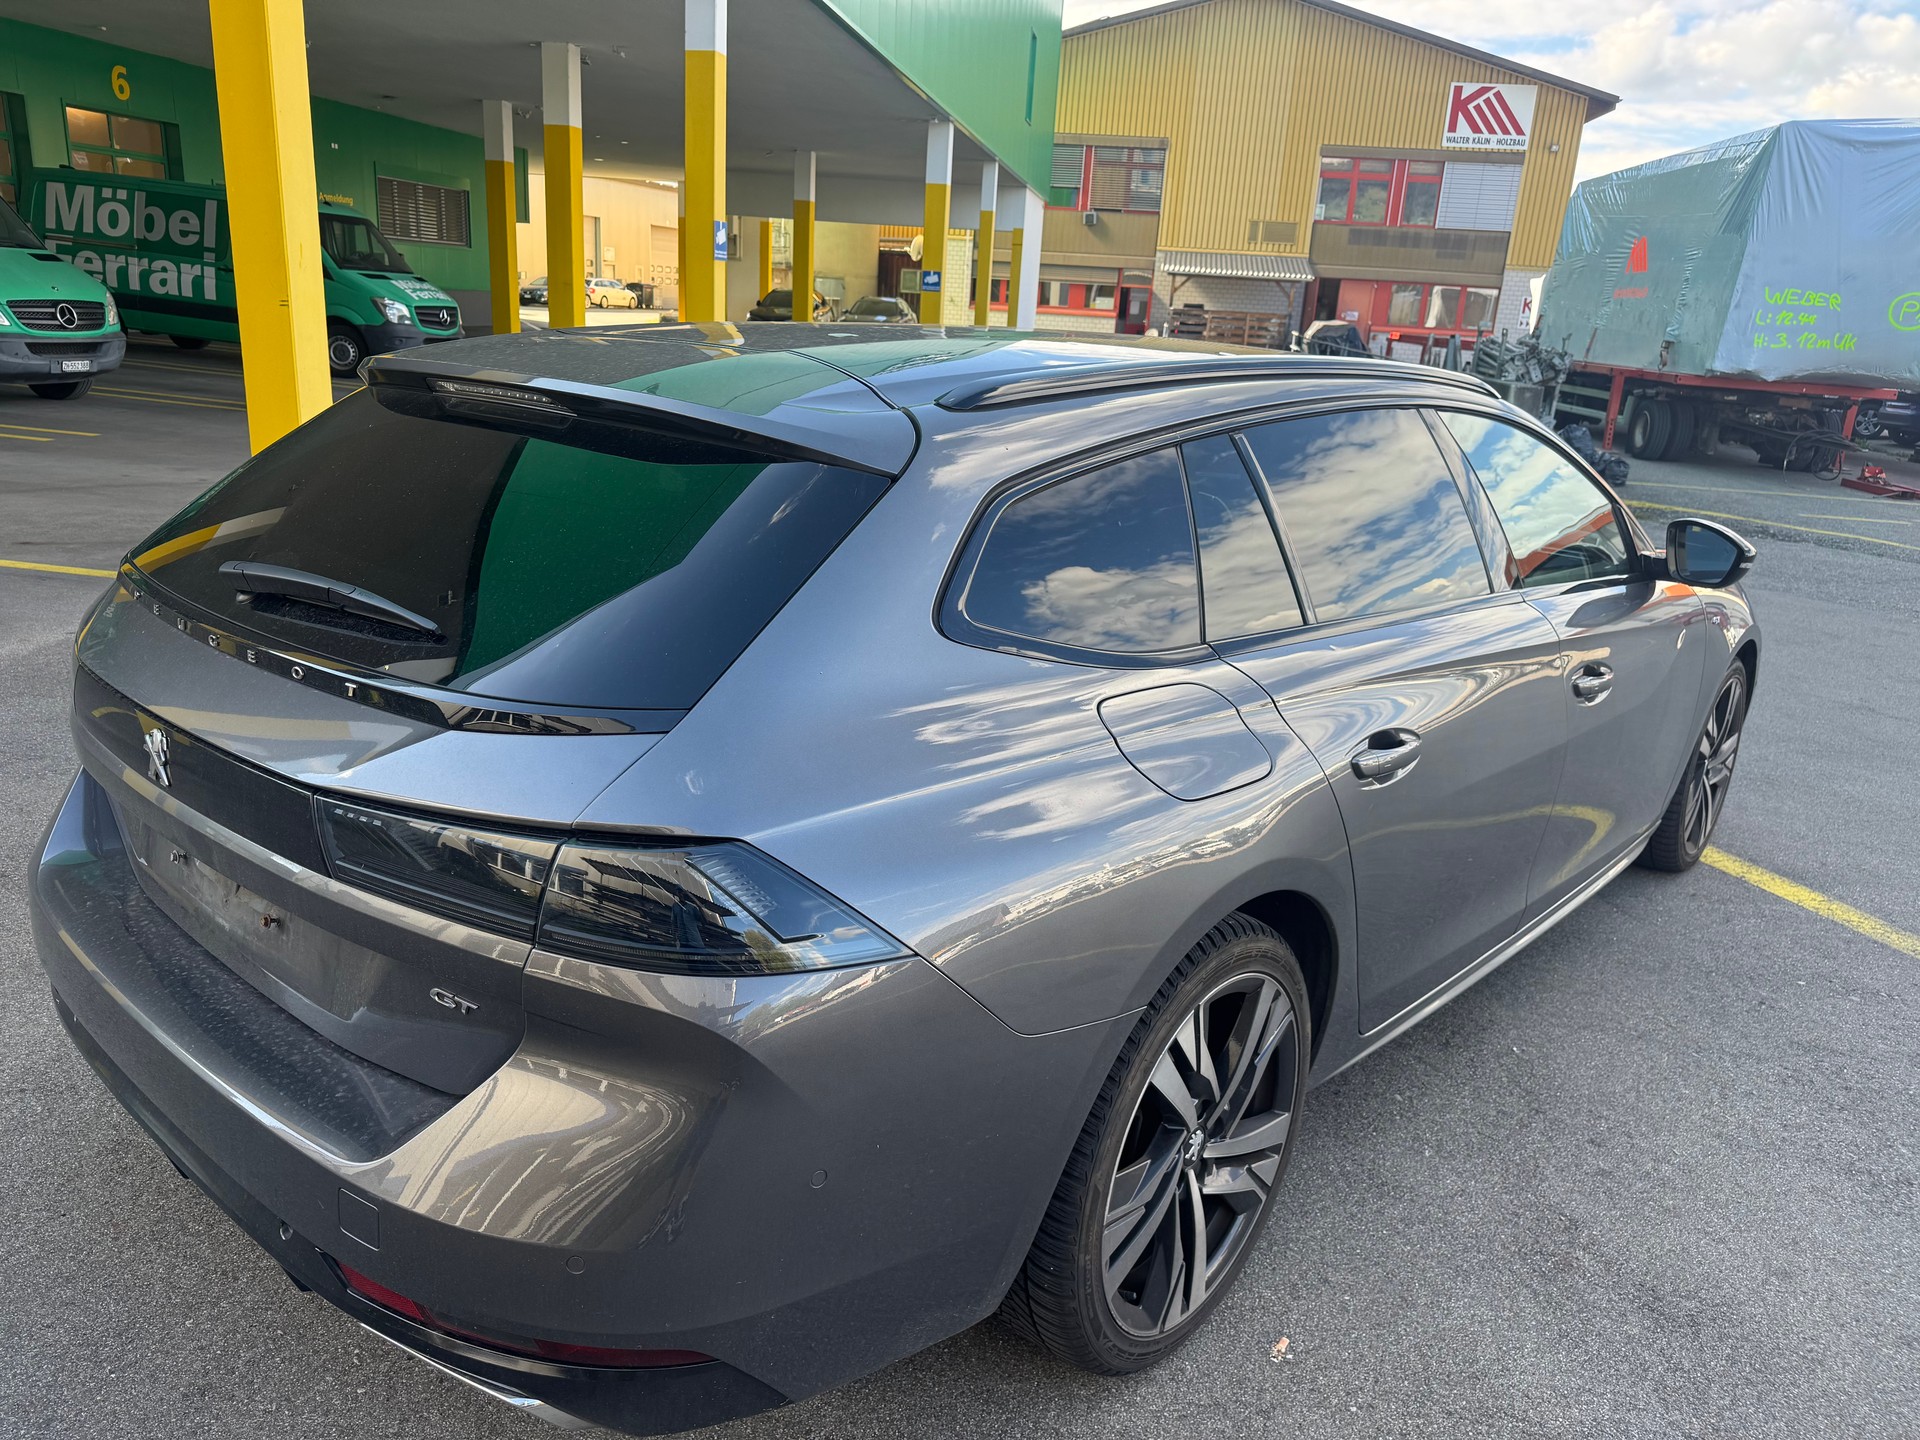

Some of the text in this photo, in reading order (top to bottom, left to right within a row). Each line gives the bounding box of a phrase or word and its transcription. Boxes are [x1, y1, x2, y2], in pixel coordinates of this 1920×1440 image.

[111, 65, 130, 101] 6
[1446, 136, 1527, 147] WALTER KÄLIN HOLZBAU
[45, 181, 218, 248] Möbel
[44, 232, 217, 301] Ferrari
[1764, 287, 1842, 312] WEBER
[1899, 300, 1920, 322] P
[133, 590, 359, 697] PEUGEOT
[429, 987, 479, 1016] GT
